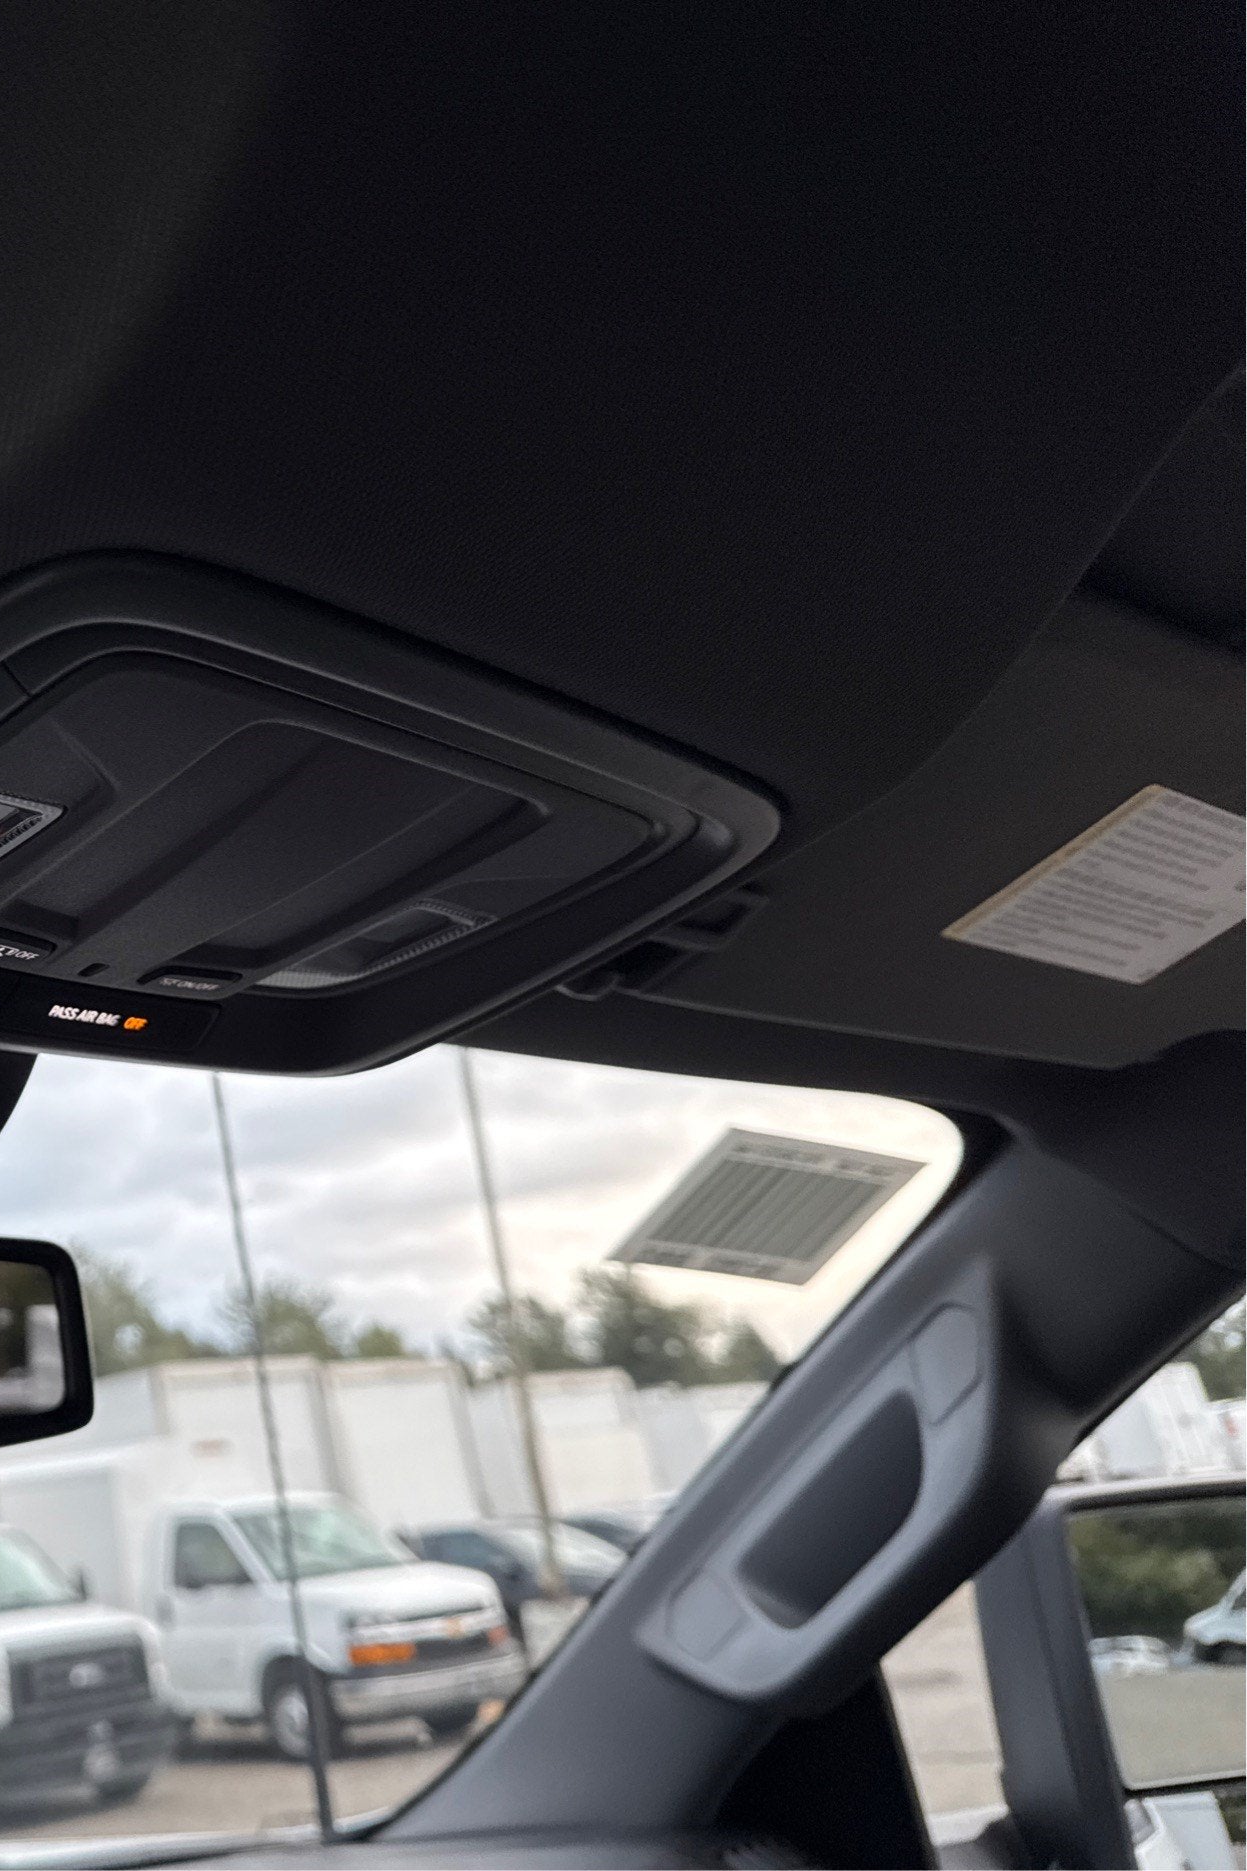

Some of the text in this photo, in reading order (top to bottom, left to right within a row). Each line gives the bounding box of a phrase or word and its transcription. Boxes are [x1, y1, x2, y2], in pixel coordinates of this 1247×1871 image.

[15, 950, 39, 960] OFF
[48, 1004, 148, 1030] PASS AIR BAG OFF
